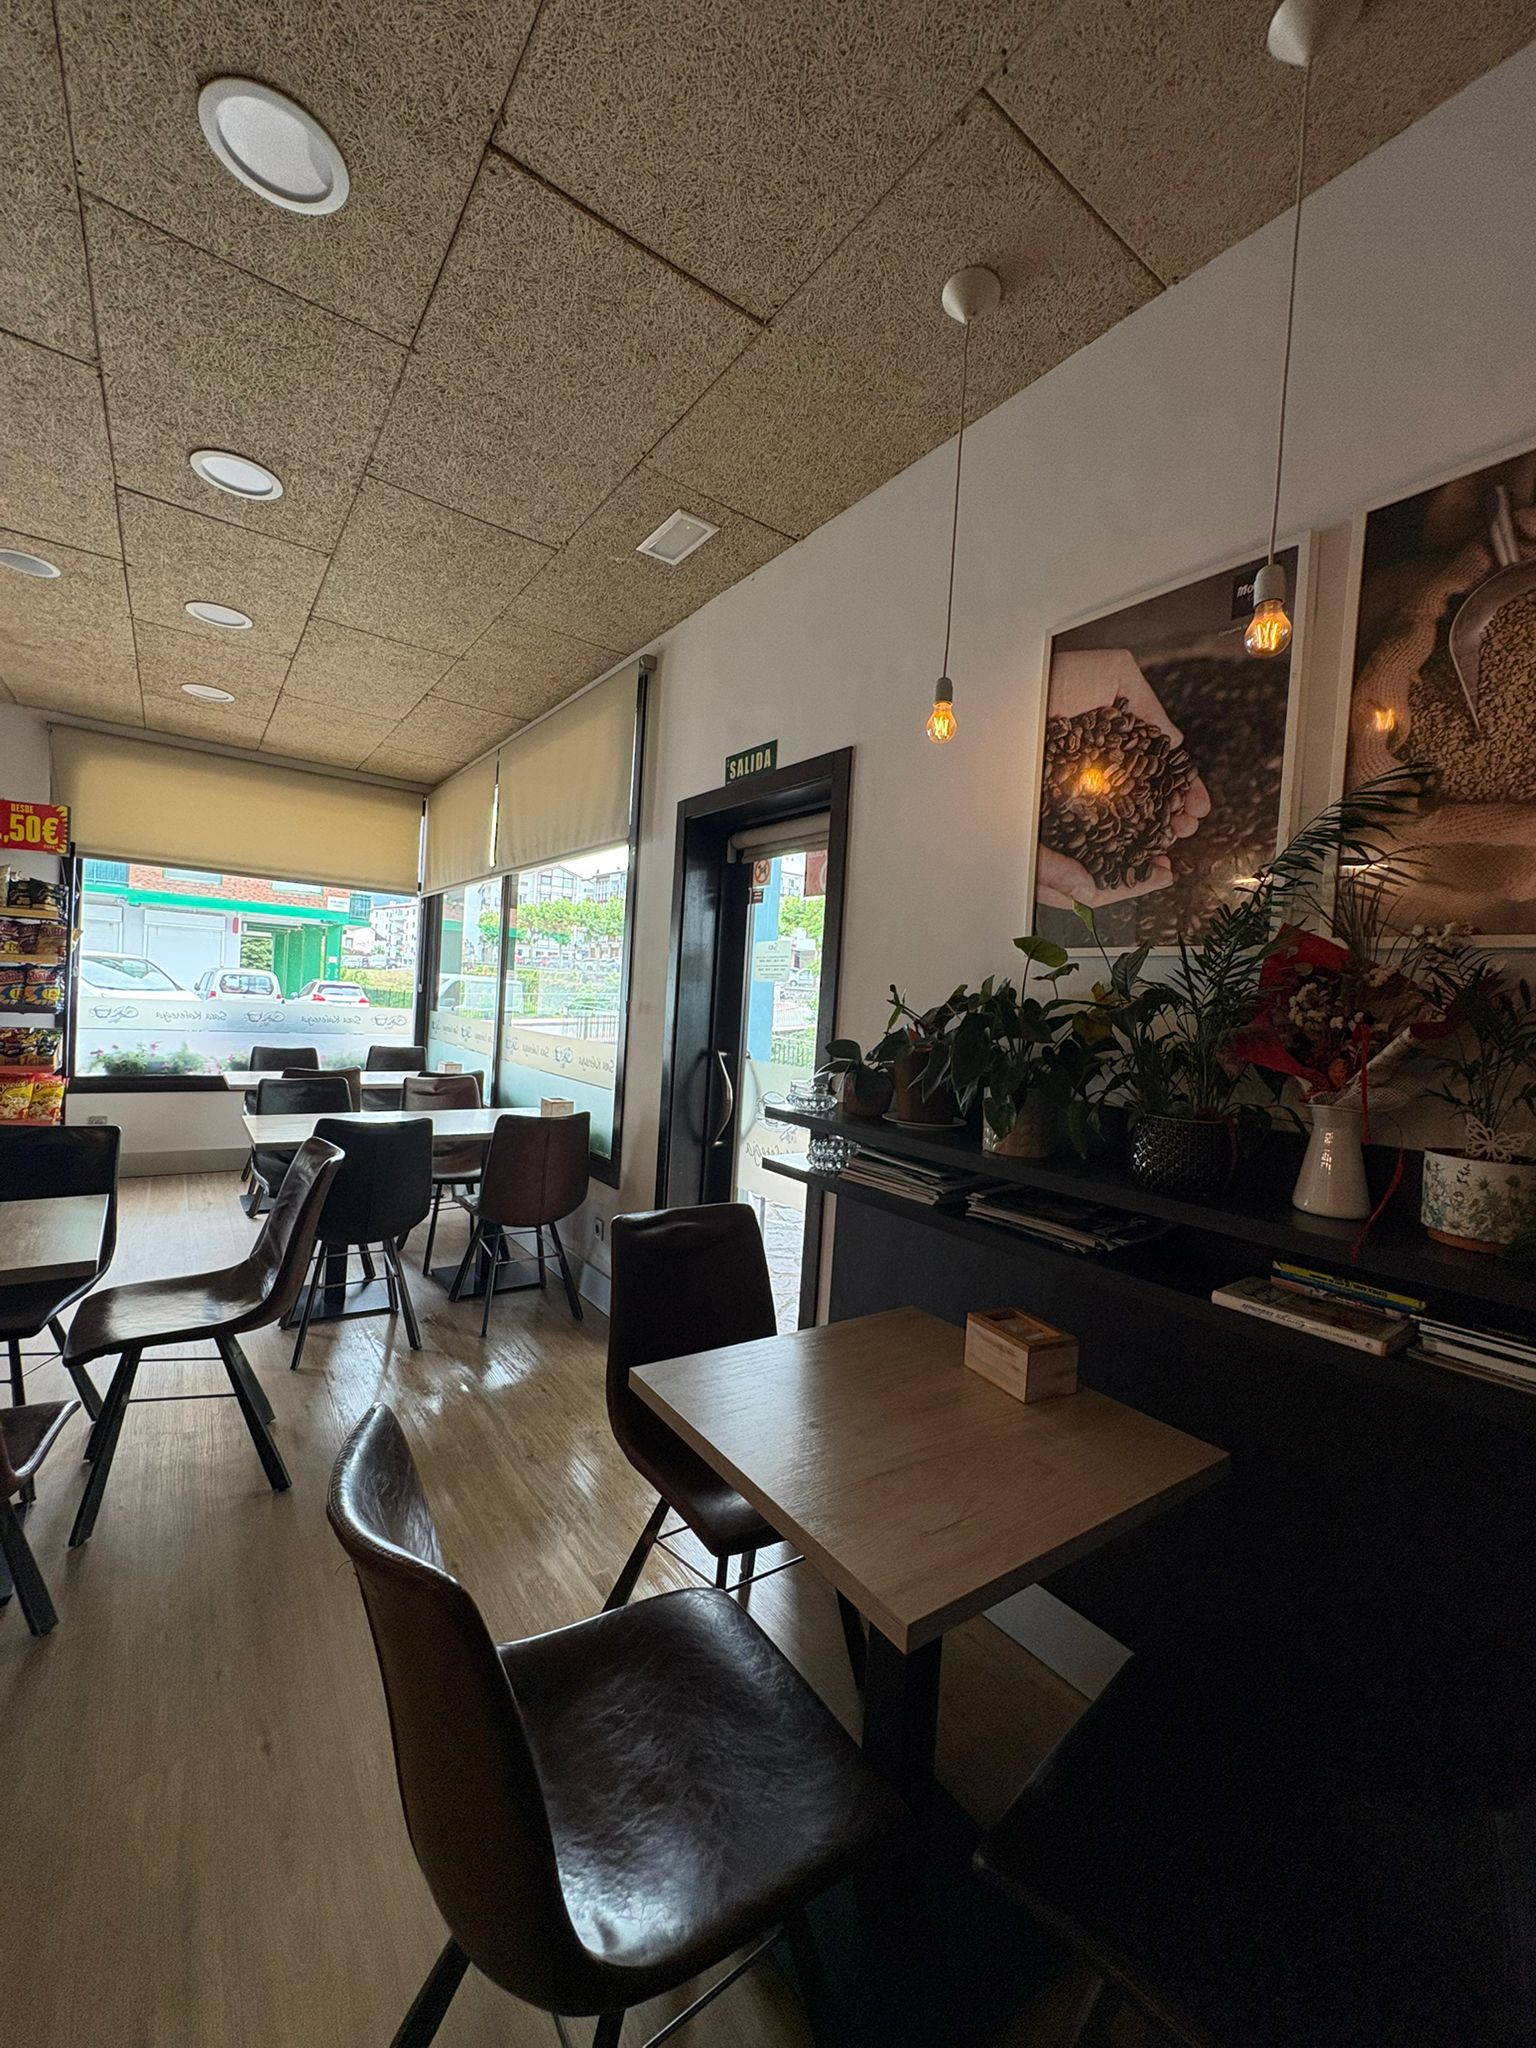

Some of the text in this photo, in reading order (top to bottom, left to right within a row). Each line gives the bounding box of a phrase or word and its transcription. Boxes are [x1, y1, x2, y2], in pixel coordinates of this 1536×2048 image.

[730, 749, 771, 780] SALIDA
[11, 803, 34, 814] DESDE
[0, 815, 59, 845] ,50€
